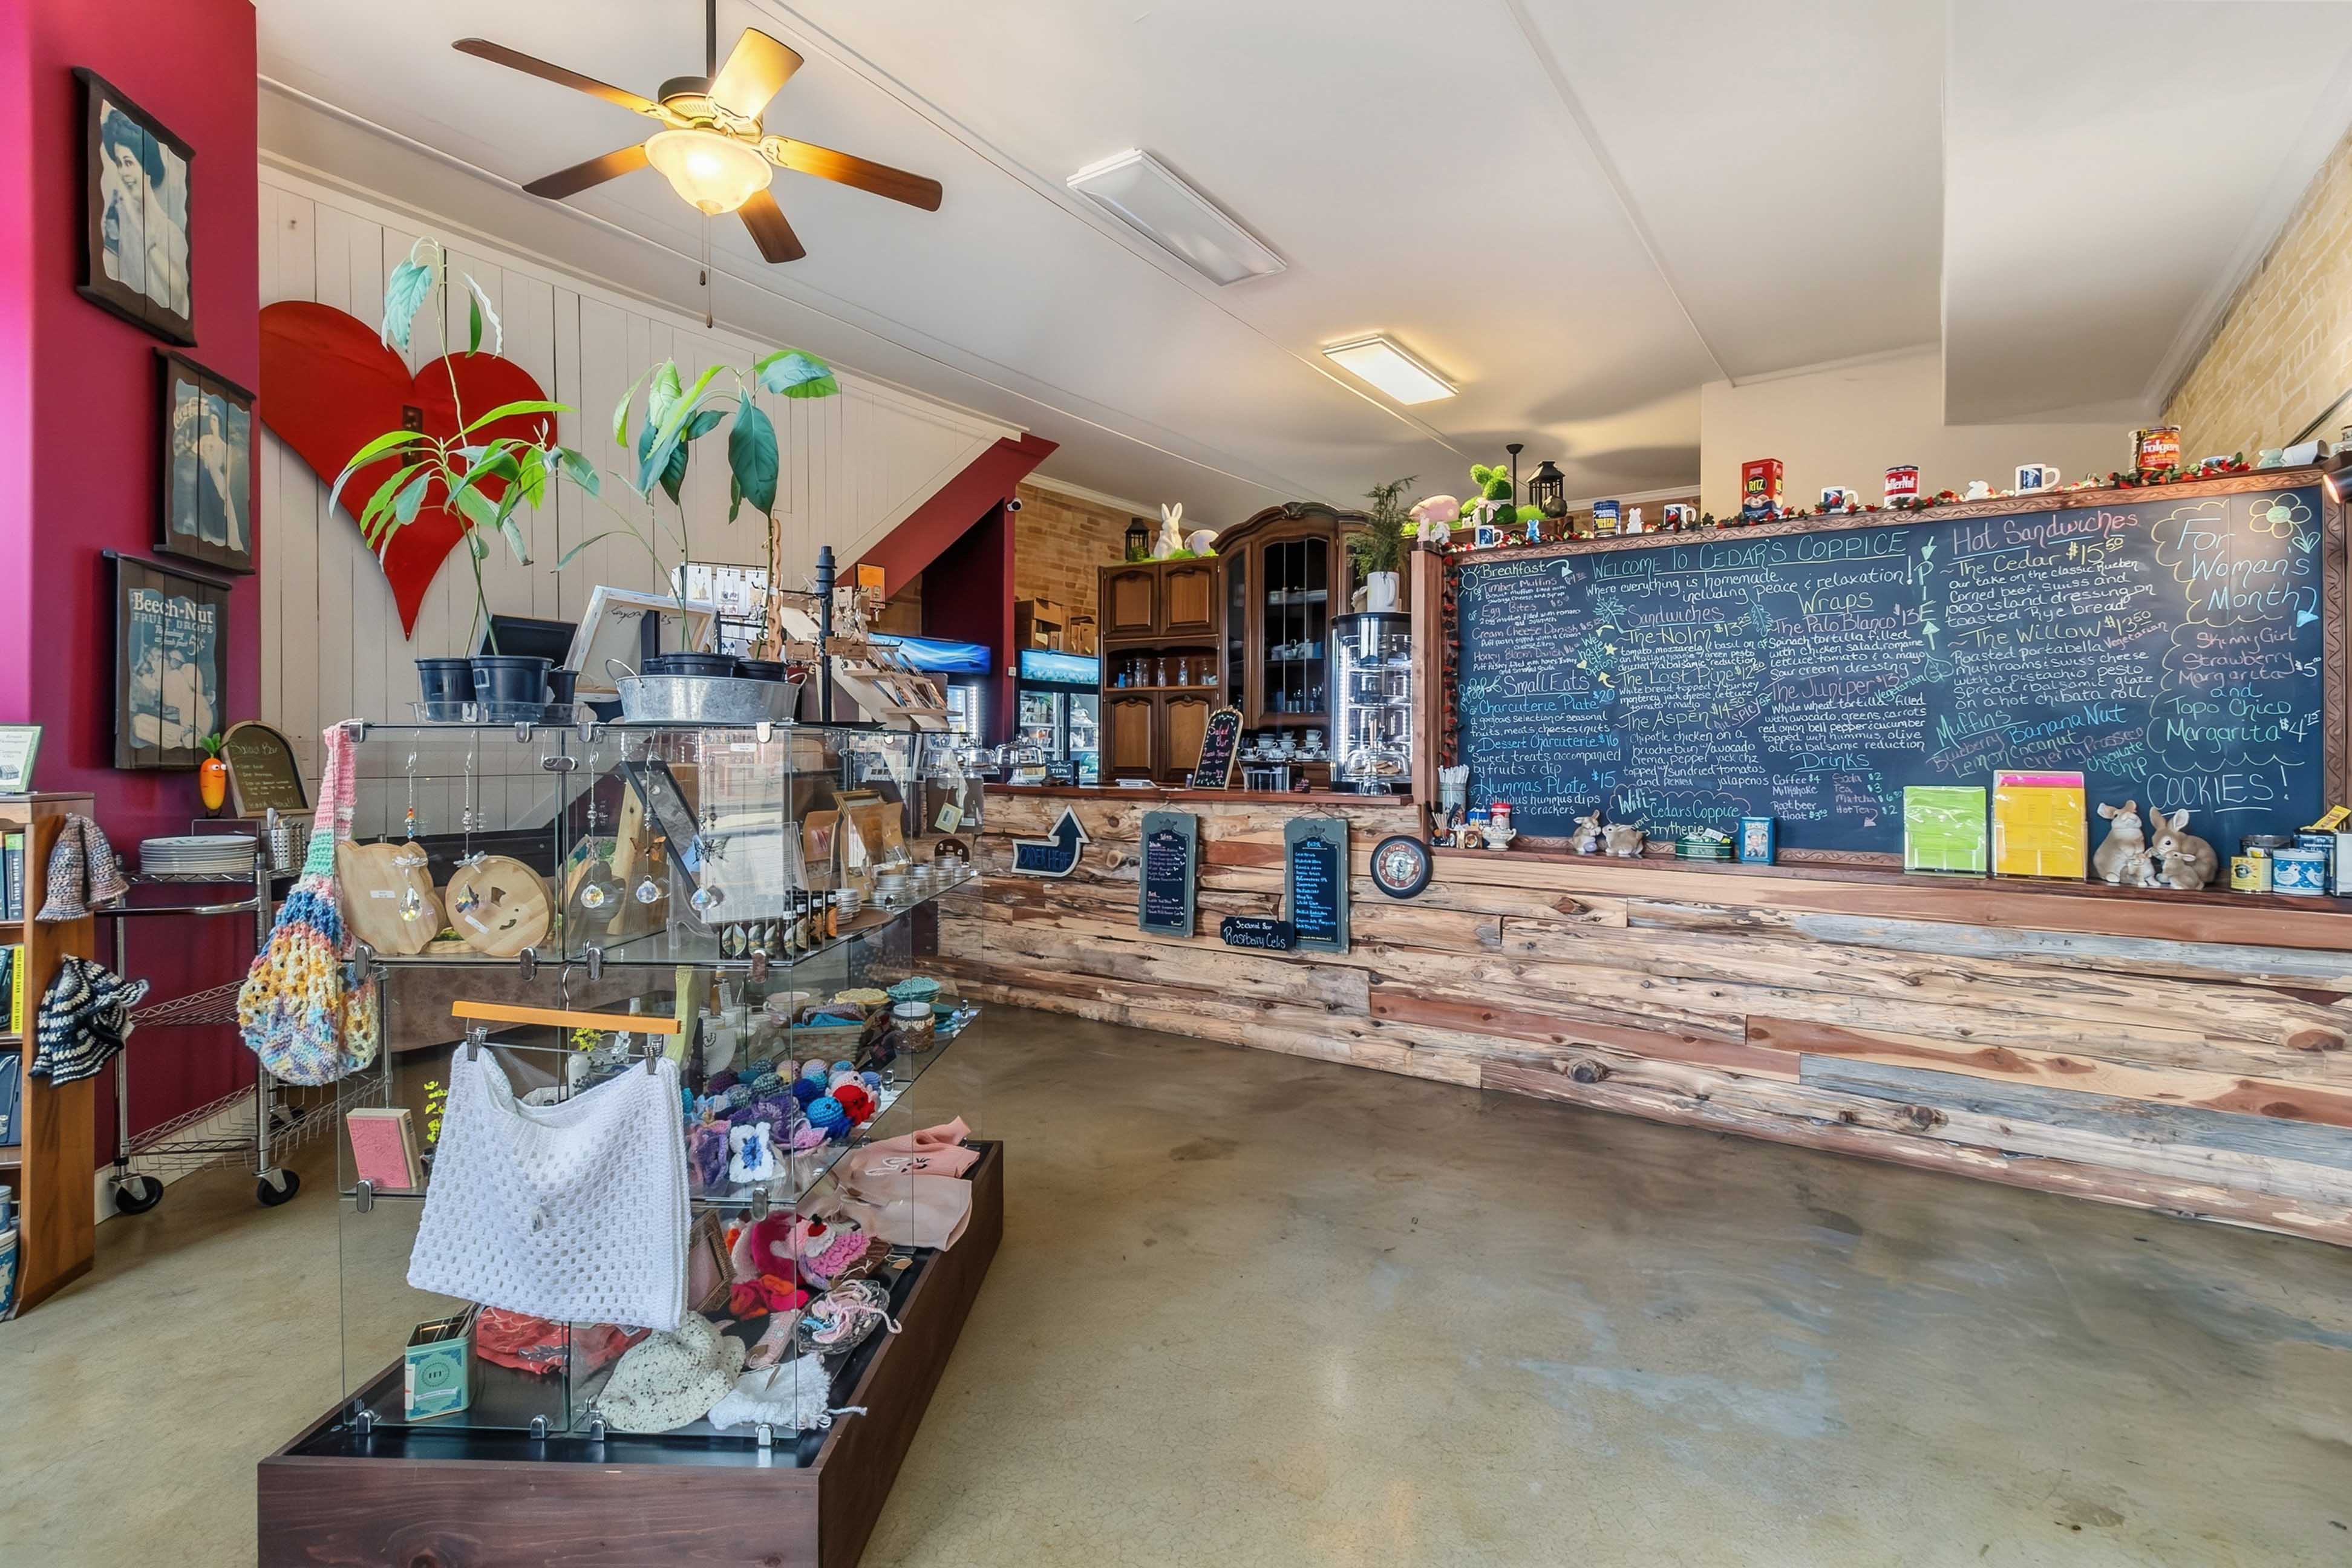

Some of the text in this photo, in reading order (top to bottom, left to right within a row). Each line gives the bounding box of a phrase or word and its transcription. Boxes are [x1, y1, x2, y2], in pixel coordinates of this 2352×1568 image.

[1748, 480, 1764, 492] RITZ
[1953, 511, 2138, 555] Hot Sandwiches
[2177, 518, 2236, 550] For
[1591, 553, 1662, 580] WELCOME
[1798, 531, 1909, 561] COPPICE
[1948, 550, 2062, 580] The Cedar
[1481, 561, 1547, 577] Breakfast
[1976, 576, 2006, 587] take
[2010, 574, 2025, 584] on
[2028, 569, 2048, 580] the
[2051, 564, 2095, 578] classic
[2192, 546, 2310, 588] Woman's
[1585, 584, 1616, 598] Where
[1621, 578, 1679, 598] everything
[1686, 576, 1698, 587] is
[2094, 573, 2132, 588] and
[1683, 582, 1798, 604] including peace
[1797, 588, 1873, 615] Wraps
[2207, 582, 2300, 612] Month
[133, 591, 213, 623] Beech-Nut
[1628, 605, 1724, 628] Sandwiches
[1945, 604, 1982, 619] 1000
[134, 613, 213, 633] FRUIT DROPS
[1774, 612, 1896, 636] The Palo Blanco
[1945, 611, 2020, 627] toasted
[1622, 629, 1656, 651] The
[1868, 630, 1911, 642] filled
[1958, 621, 2102, 650] The Willow
[1800, 643, 1842, 656] chicken
[1950, 641, 2102, 665] Roasted portabella
[2100, 650, 2149, 664] cheese
[1799, 662, 1909, 679] cream dressing
[2183, 650, 2295, 674] Strawberry
[1503, 670, 1590, 697] Small Eats
[1616, 667, 1736, 688] The Lost Pine
[2011, 664, 2144, 684] pistachio pesto
[1763, 675, 1876, 702] The Juniper
[1895, 693, 1927, 706] filled
[2210, 682, 2263, 697] and
[1478, 699, 1557, 717] Charcuterie
[1558, 693, 1599, 710] Plate
[2164, 696, 2291, 722] Topo Chico
[1619, 710, 1652, 731] The
[1936, 710, 2011, 749] Muffins
[2001, 701, 2128, 745] Banana Nut
[1477, 737, 1527, 752] Dessert
[2167, 719, 2282, 754] Margarita
[1540, 762, 1562, 779] dip
[1789, 752, 1870, 771] Drinks
[1543, 775, 1589, 794] Plate
[1650, 798, 1740, 823] Cedars Coppice
